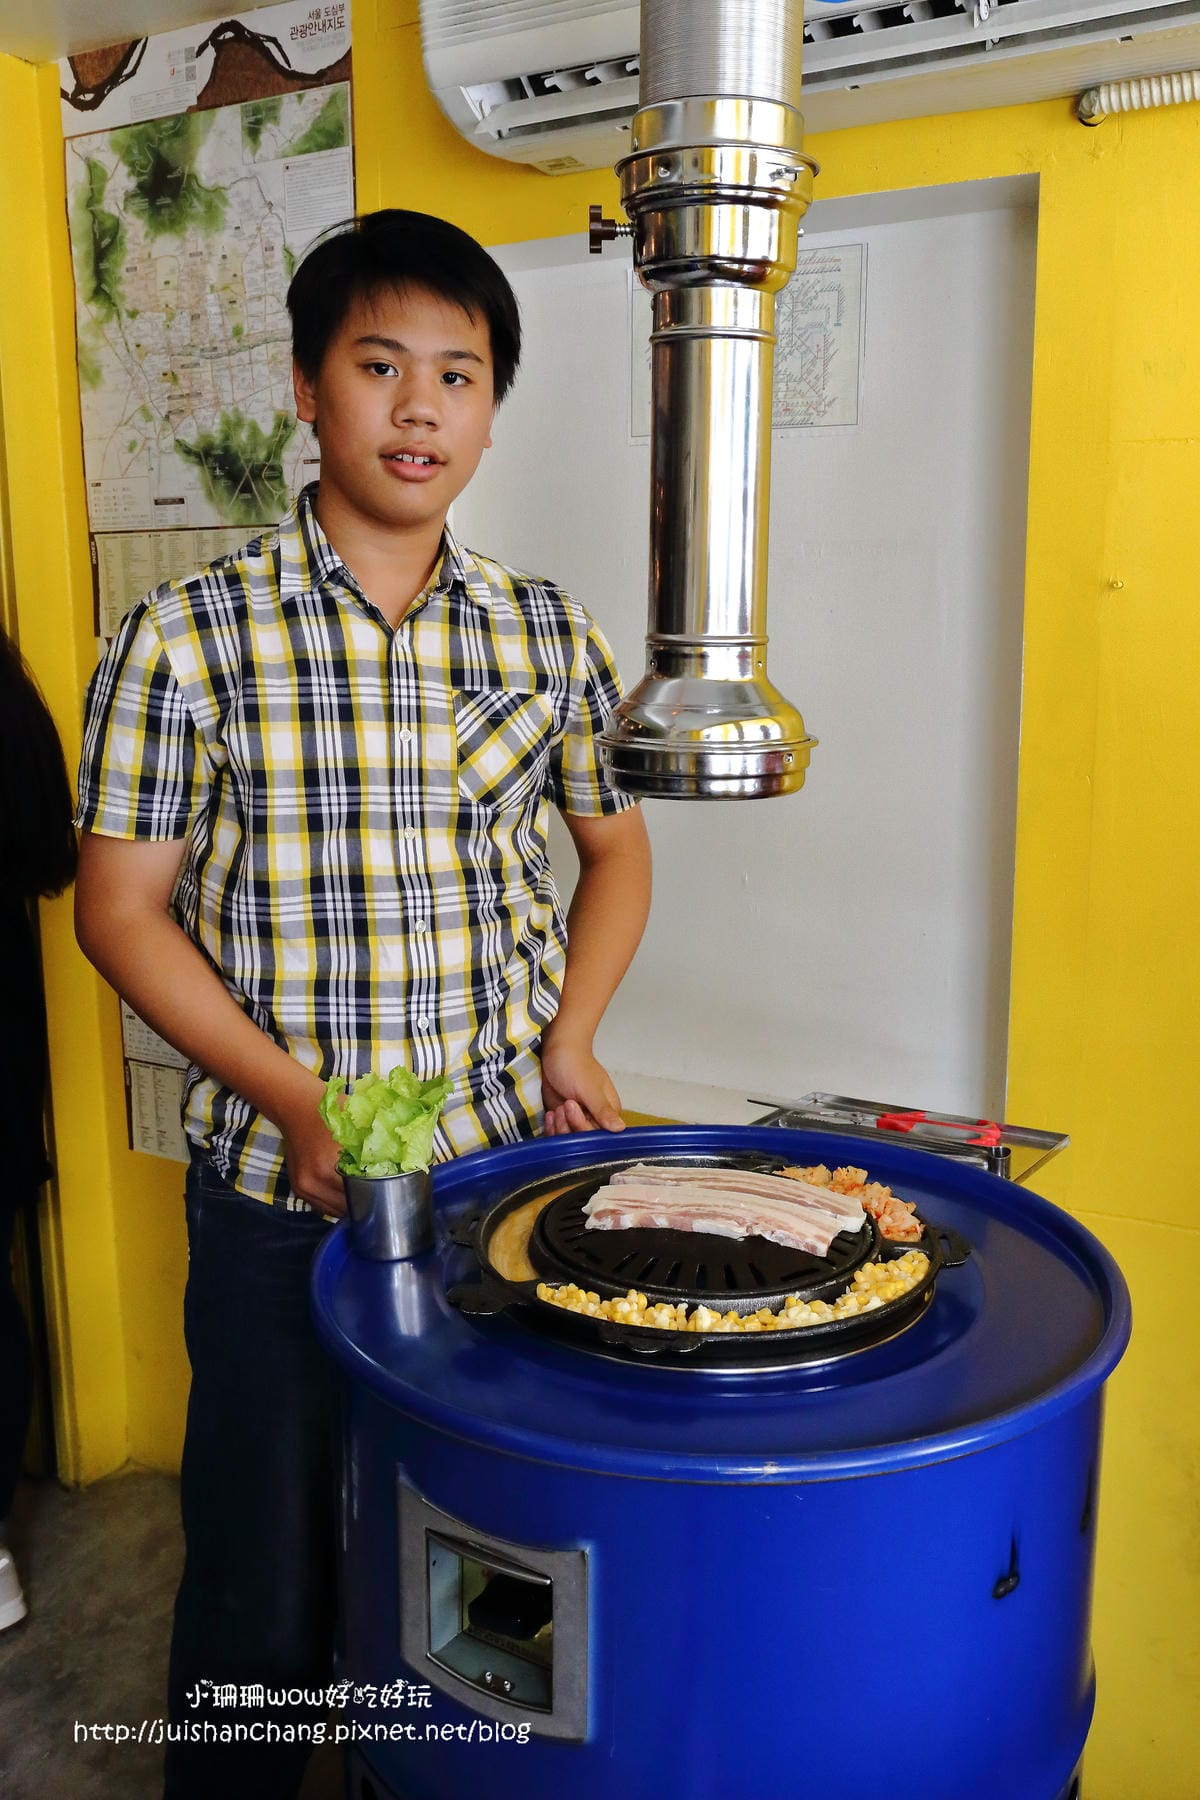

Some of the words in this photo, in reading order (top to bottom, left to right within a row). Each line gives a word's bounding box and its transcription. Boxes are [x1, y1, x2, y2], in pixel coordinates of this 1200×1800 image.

[308, 8, 321, 20] 서울
[324, 3, 345, 17] 도심부
[290, 16, 345, 40] 관광안내지도
